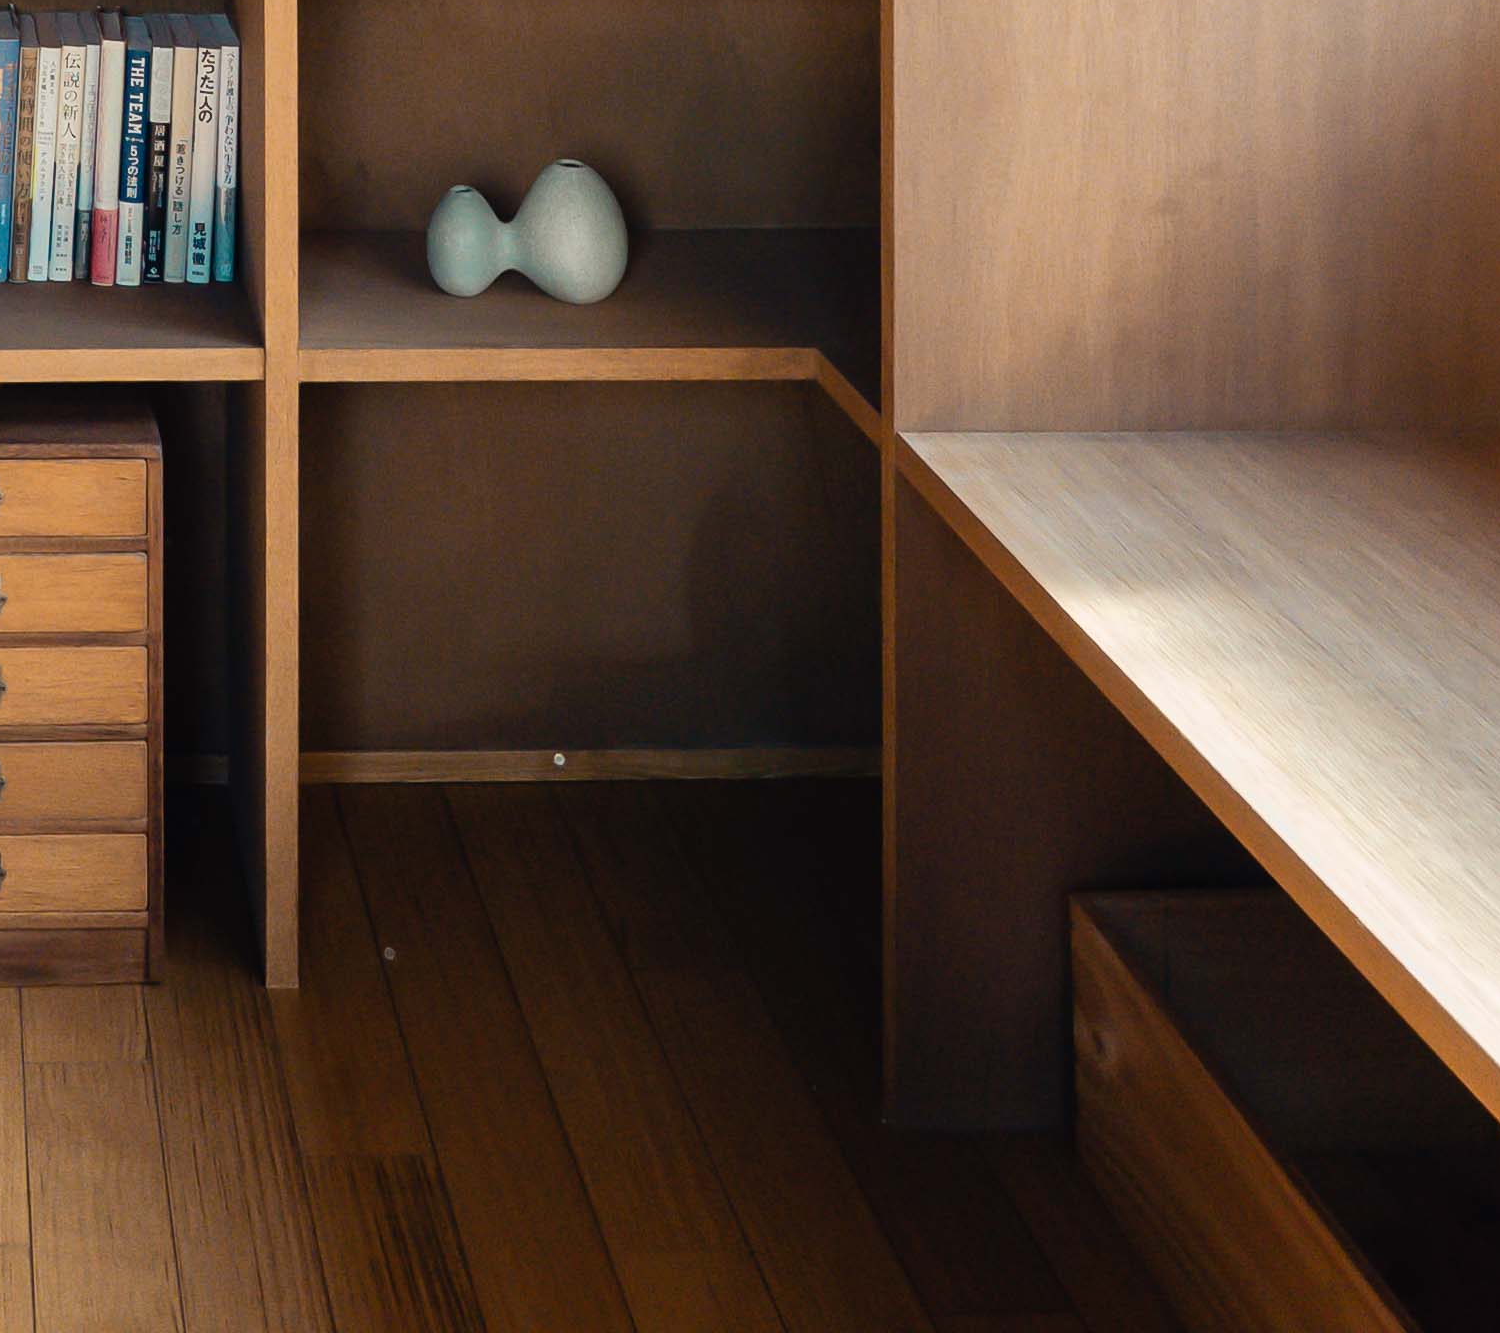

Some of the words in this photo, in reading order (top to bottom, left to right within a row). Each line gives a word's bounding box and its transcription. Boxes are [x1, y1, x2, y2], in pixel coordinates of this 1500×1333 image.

[130, 57, 146, 88] THE
[199, 49, 216, 124] たった一人の
[63, 52, 81, 139] 伝説の新人
[127, 93, 144, 135] TEAM
[193, 222, 207, 267] 見城徹
